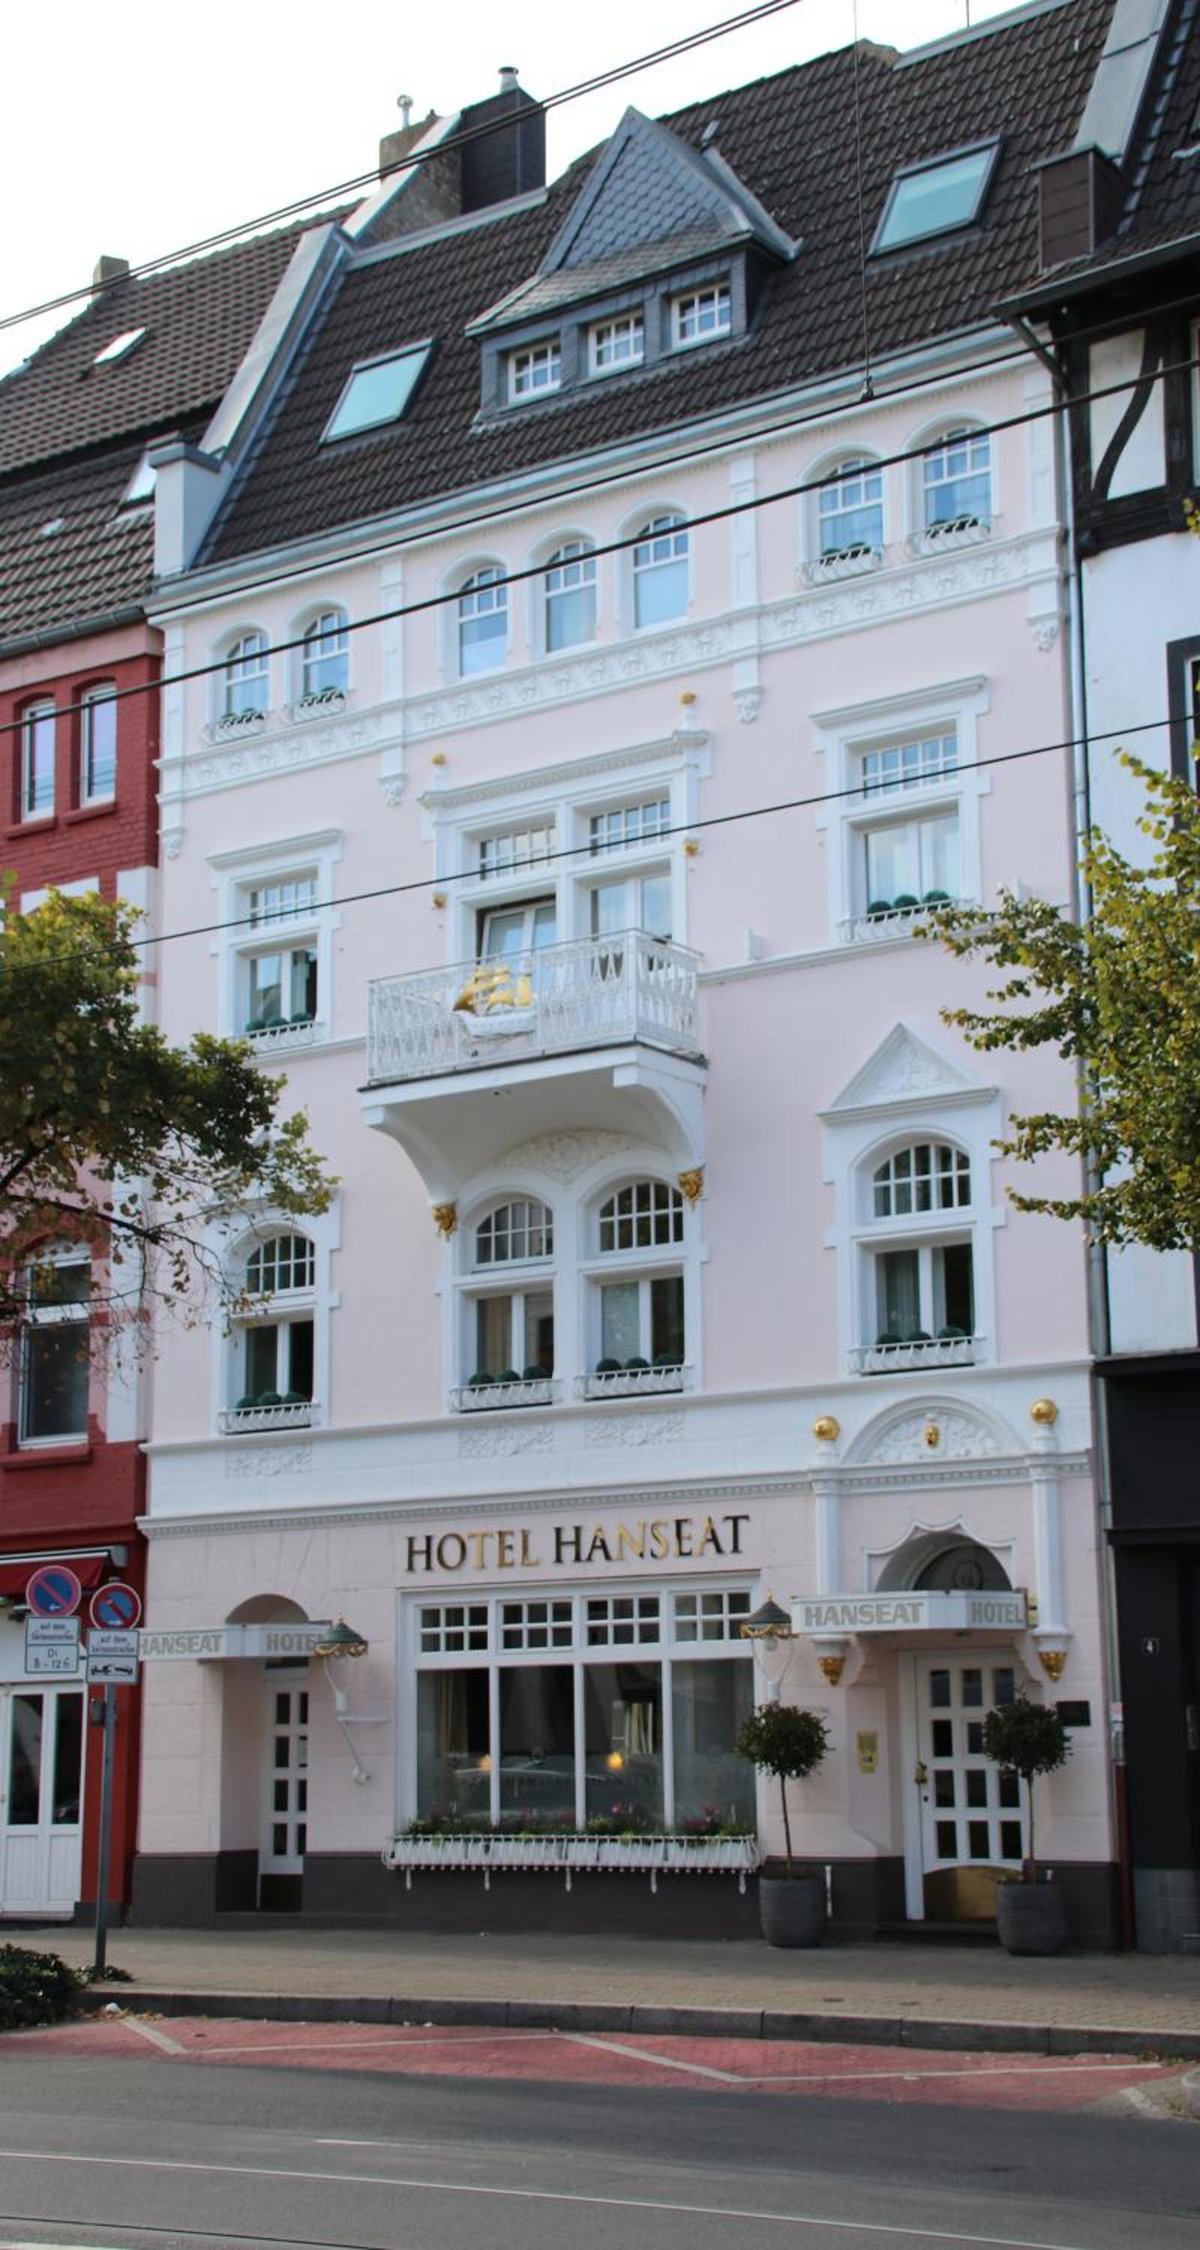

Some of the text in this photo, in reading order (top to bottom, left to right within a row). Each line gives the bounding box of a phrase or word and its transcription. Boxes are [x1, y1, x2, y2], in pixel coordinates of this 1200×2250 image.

[405, 1514, 750, 1572] HOTEL HANSEAT
[804, 1602, 924, 1627] HANSEAT
[970, 1601, 1024, 1625] HOTEL
